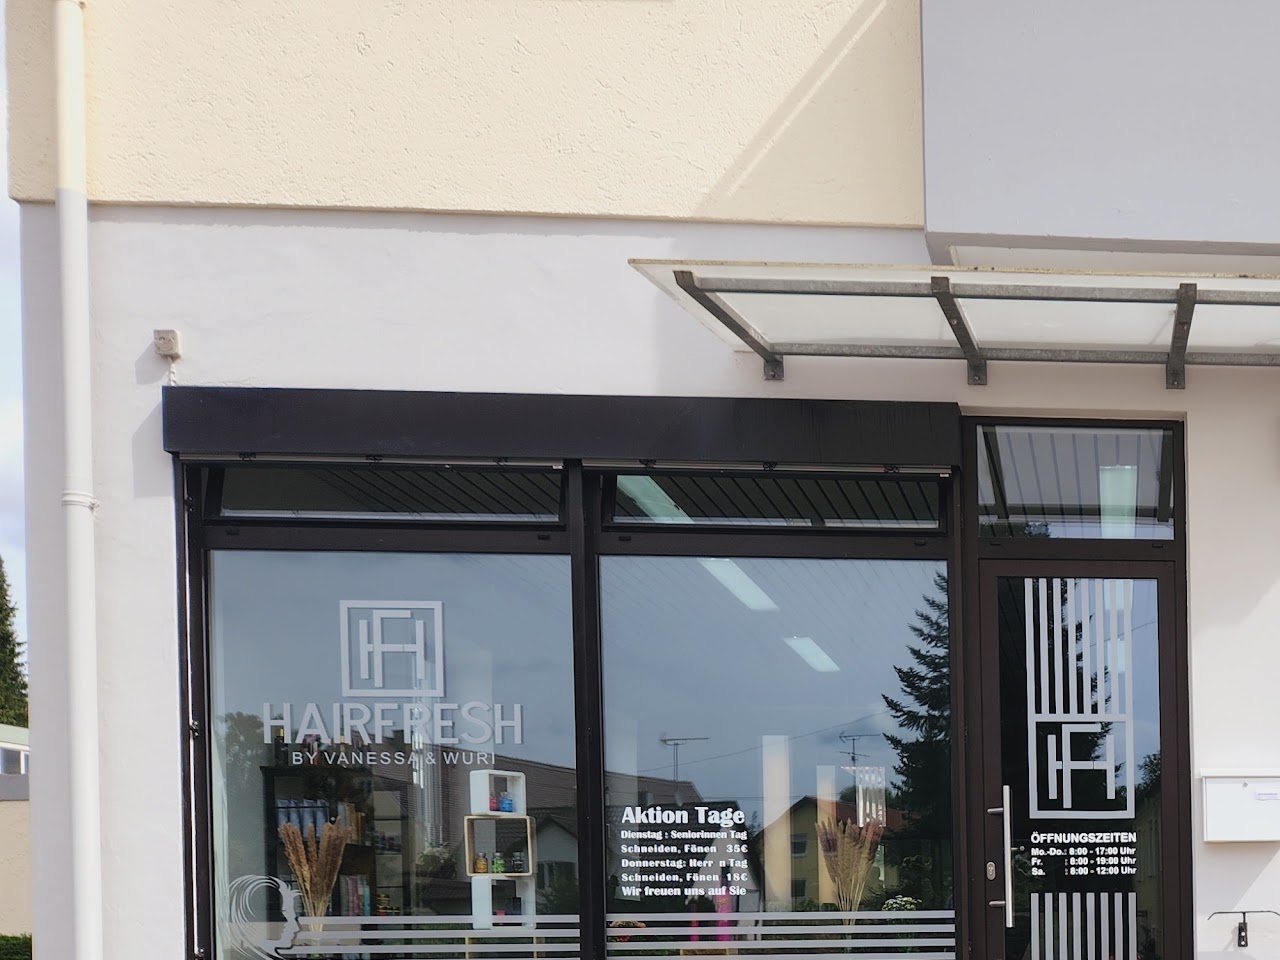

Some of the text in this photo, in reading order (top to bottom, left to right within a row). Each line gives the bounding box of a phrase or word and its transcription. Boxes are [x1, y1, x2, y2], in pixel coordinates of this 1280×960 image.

[263, 701, 523, 745] HAIRFRESH
[292, 751, 496, 765] BY VANESSA & WURI
[621, 806, 745, 828] Aktion Tage
[620, 830, 663, 840] Dienstag
[670, 830, 727, 839] Seniorinnen
[729, 830, 748, 840] Tag
[1030, 831, 1137, 843] ÖFFNUNGSZEITEN
[620, 844, 749, 854] Schneiden, Fönen 35€
[1068, 847, 1088, 855] 8:00
[1095, 847, 1118, 855] 17:00
[1120, 847, 1136, 855] Uhr
[621, 858, 687, 869] Donnerstag:
[728, 858, 748, 869] Tag
[1031, 858, 1043, 866] Fr.
[1069, 857, 1088, 865] 8:00
[1096, 857, 1119, 865] 19:00
[1120, 857, 1137, 865] Uhr
[1031, 868, 1046, 876] Sa.
[1070, 867, 1089, 875] 8:00
[1096, 866, 1119, 875] 12:00
[1121, 866, 1137, 874] Uhr
[621, 873, 748, 883] Schneiden, Fönen 18€
[621, 886, 747, 896] Wir freuen uns auf Sie
